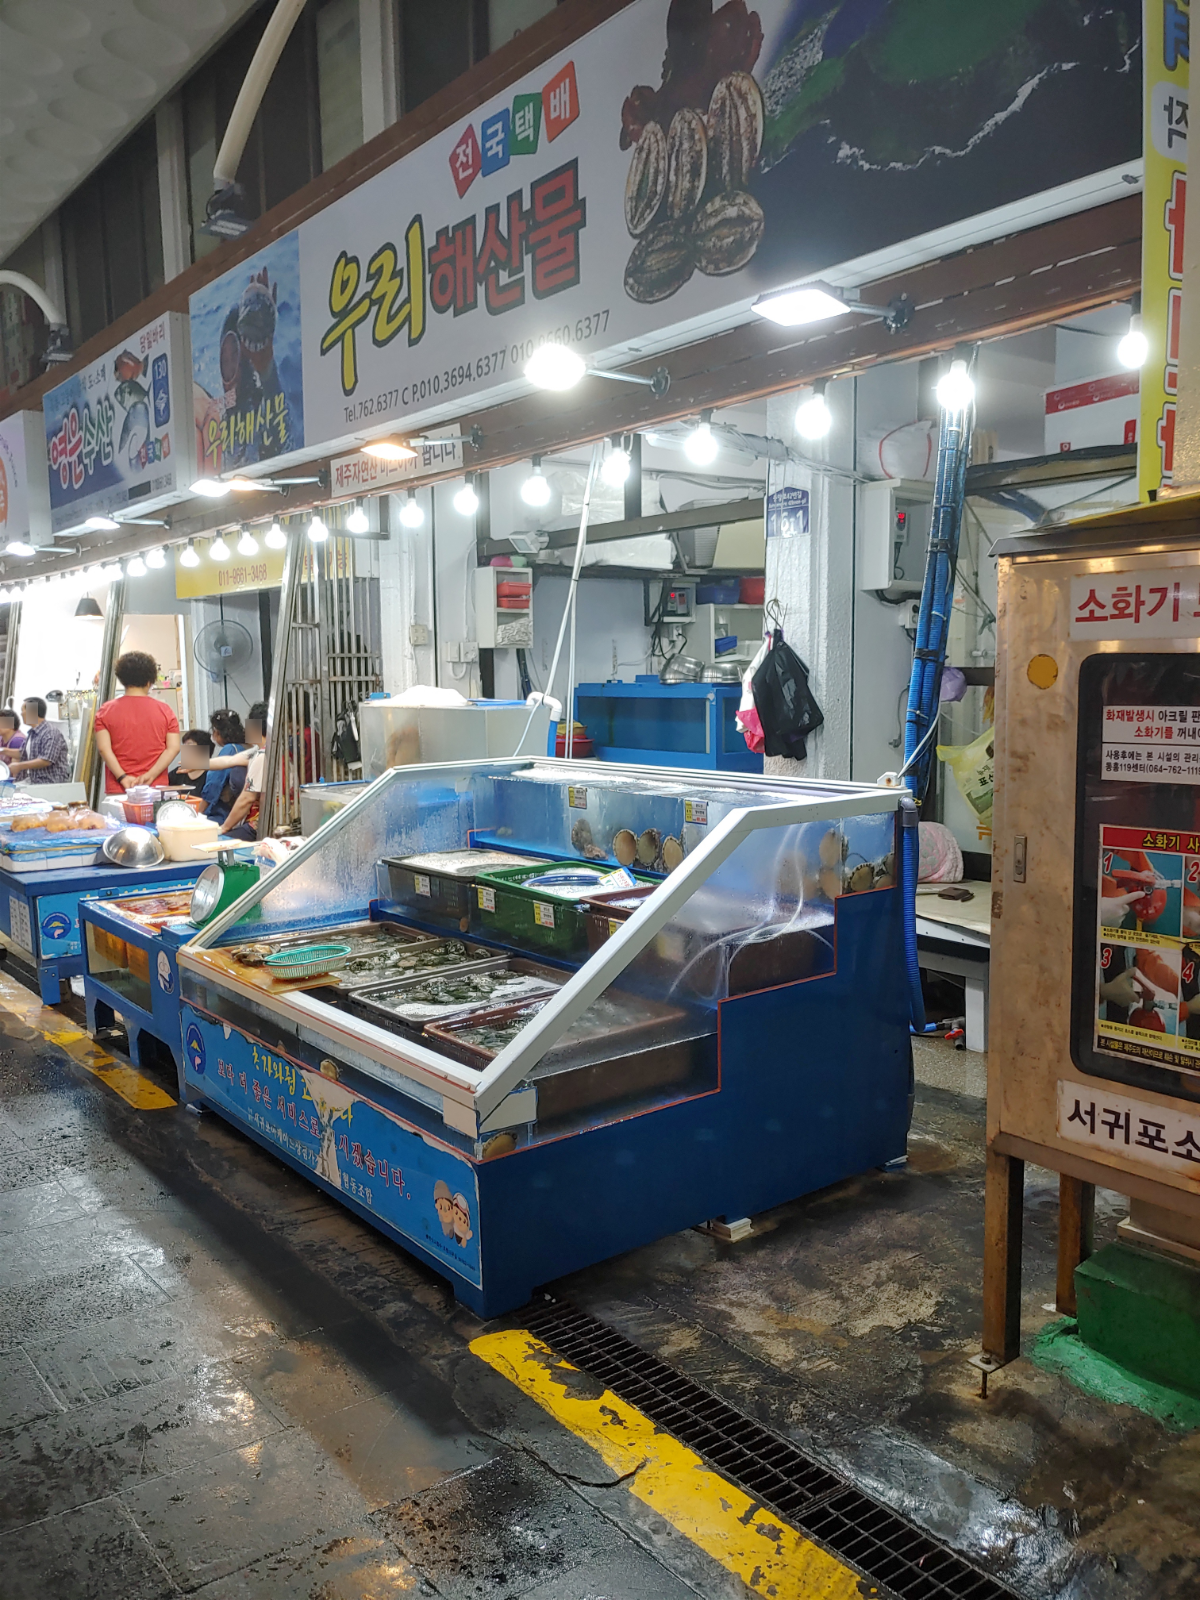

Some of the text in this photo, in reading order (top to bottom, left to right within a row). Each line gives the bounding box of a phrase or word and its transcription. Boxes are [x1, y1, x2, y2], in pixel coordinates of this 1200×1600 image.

[454, 77, 571, 182] 전국택배
[320, 155, 587, 397] 우리해산물
[155, 358, 167, 380] 130
[344, 389, 399, 424] Tel.762.6377
[50, 397, 114, 490] 영은수산
[205, 392, 289, 470] 우리해산물
[335, 459, 378, 488] 제주자연산
[1075, 581, 1181, 624] 소화기
[1106, 709, 1155, 723] 화재발생시
[1158, 710, 1188, 723] 아크릴
[1134, 726, 1174, 740] 소화기를
[1105, 749, 1143, 761] 사용후에는
[1157, 752, 1180, 763] 시설의
[1184, 753, 1200, 764] 관리
[1142, 832, 1180, 851] 소화기
[1103, 852, 1113, 874] 1
[1188, 861, 1200, 883] 2
[1101, 948, 1112, 969] 3
[1182, 962, 1195, 984] 4
[252, 1078, 273, 1110] 좋은
[277, 1093, 321, 1139] 서비스로
[334, 1130, 411, 1201] 시겠습니다.
[1066, 1098, 1200, 1164] 서귀포소
